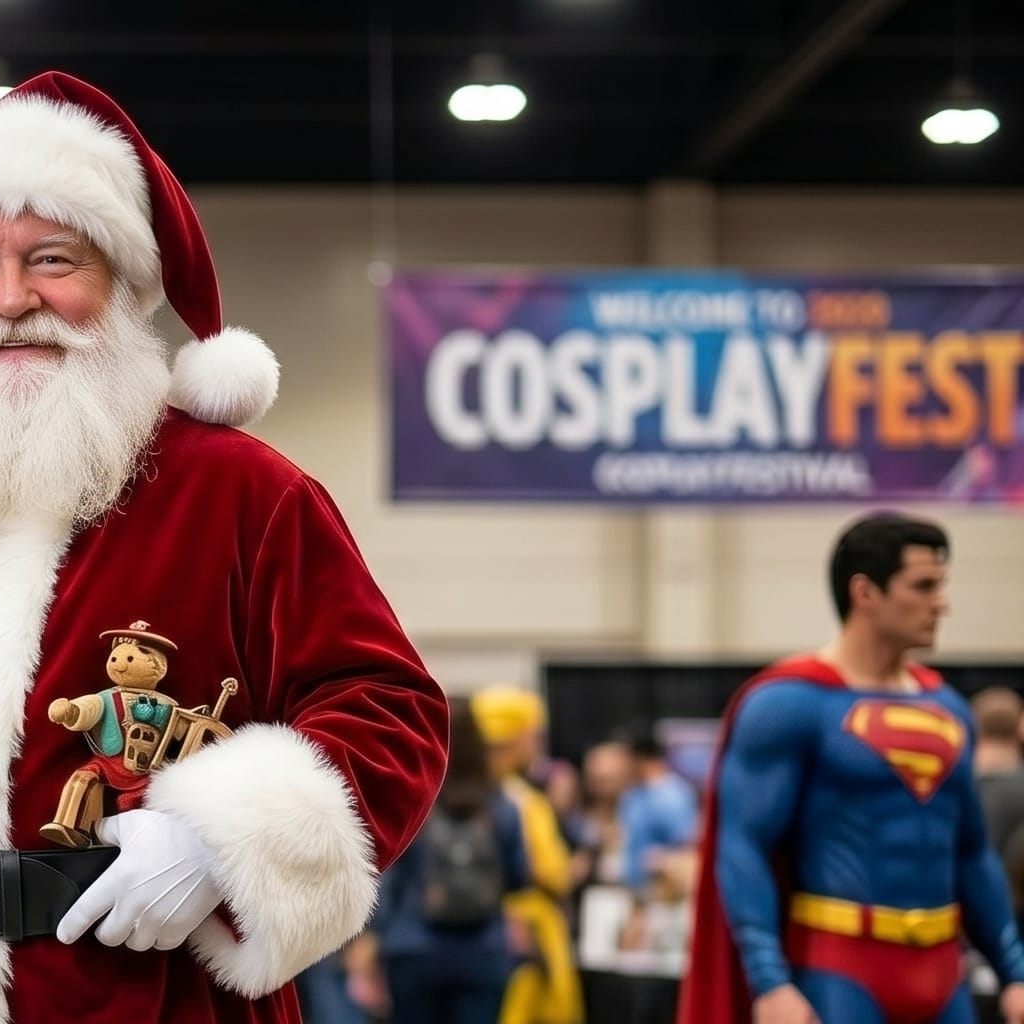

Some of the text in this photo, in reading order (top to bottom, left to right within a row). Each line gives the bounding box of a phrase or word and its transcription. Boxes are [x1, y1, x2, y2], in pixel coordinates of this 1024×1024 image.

[592, 291, 747, 329] WELCOME
[756, 291, 805, 329] TO
[425, 329, 1024, 449] COSPLAYFEST
